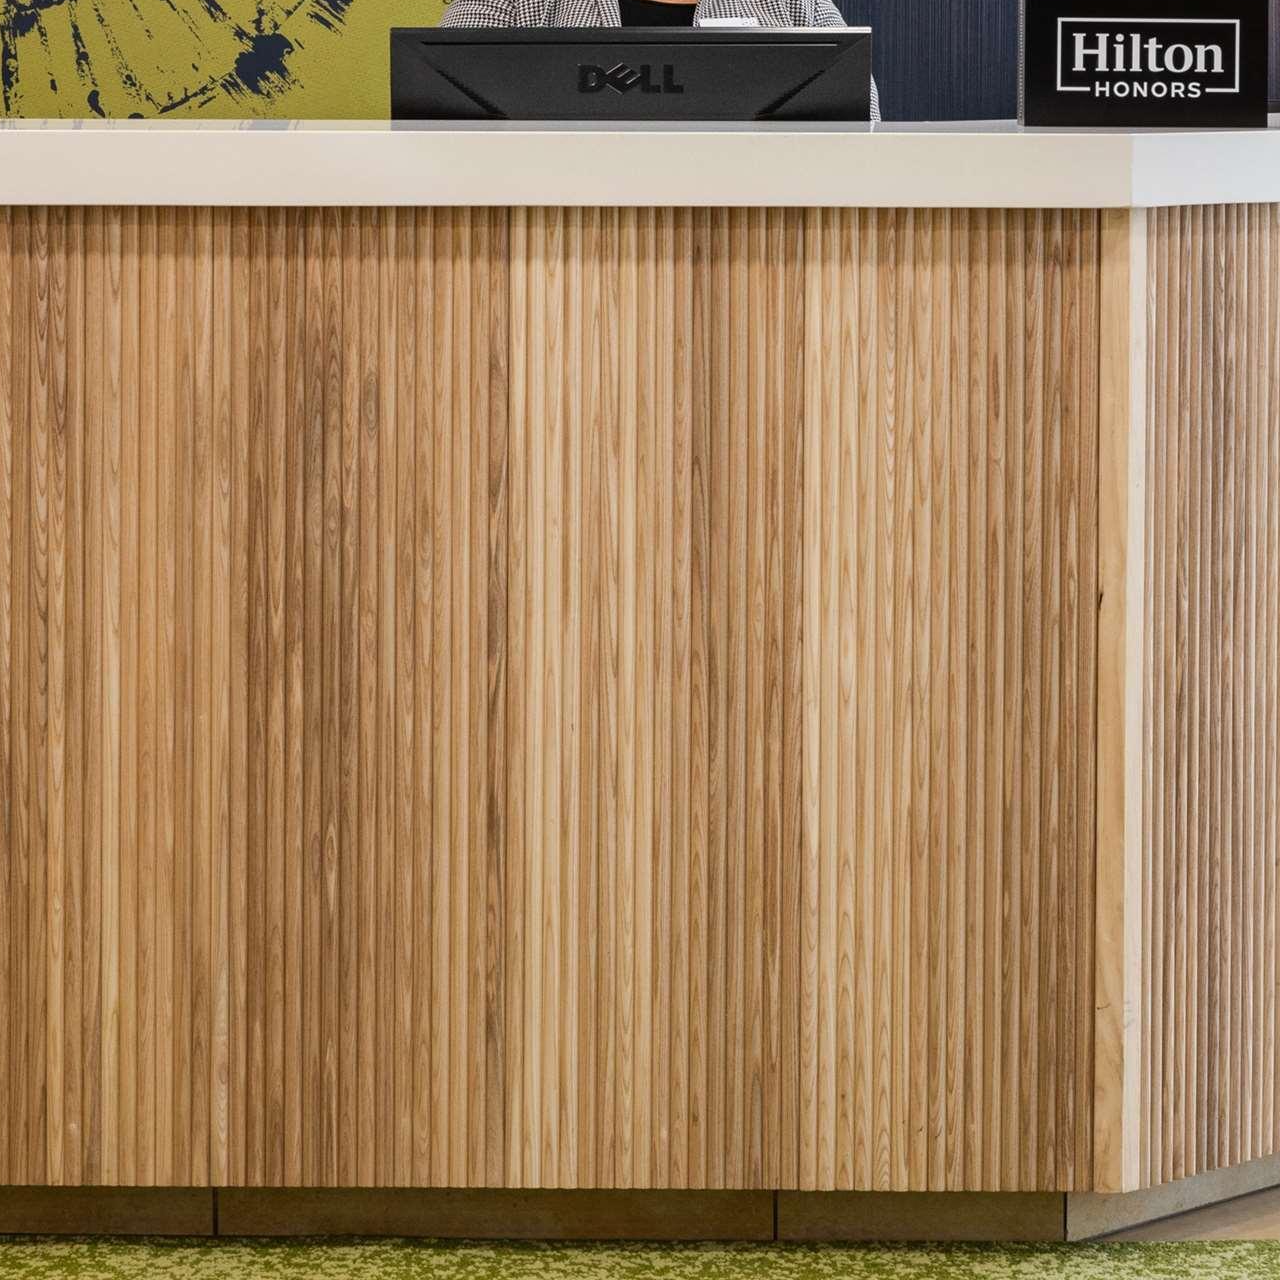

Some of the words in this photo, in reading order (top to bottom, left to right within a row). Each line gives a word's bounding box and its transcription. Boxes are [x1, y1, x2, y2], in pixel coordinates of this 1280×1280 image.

[1071, 31, 1225, 74] Hilton
[576, 62, 685, 95] DELL
[1093, 80, 1202, 99] HONORS
